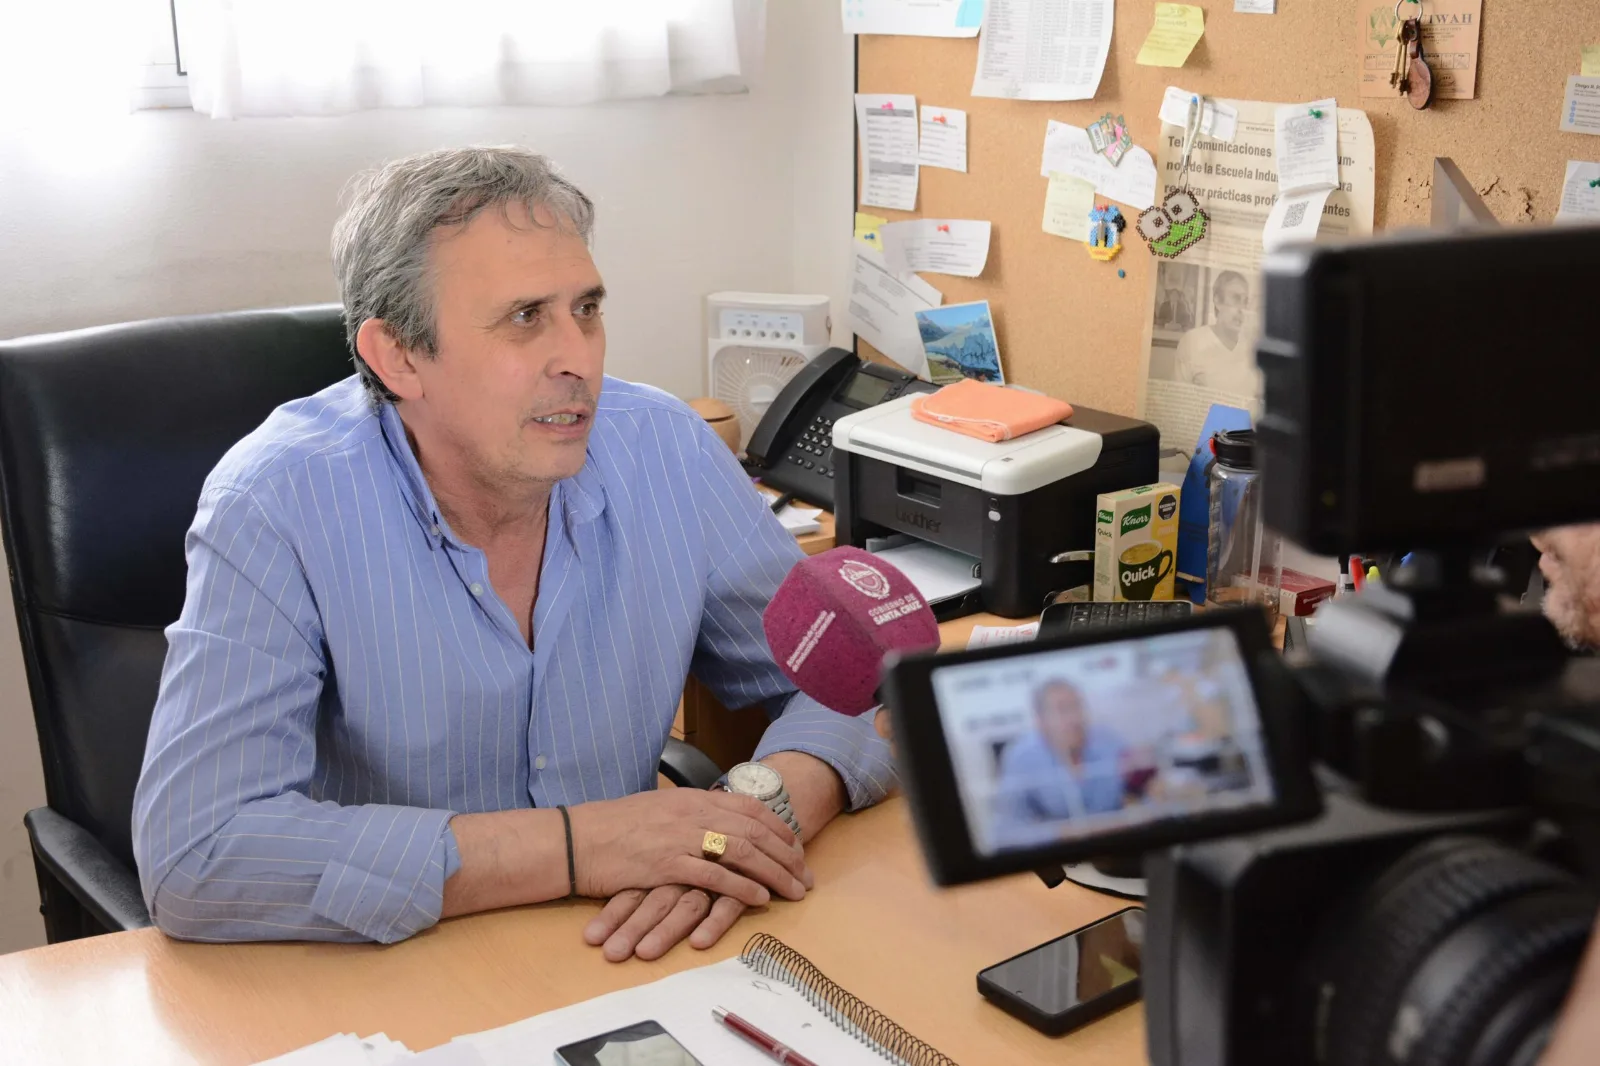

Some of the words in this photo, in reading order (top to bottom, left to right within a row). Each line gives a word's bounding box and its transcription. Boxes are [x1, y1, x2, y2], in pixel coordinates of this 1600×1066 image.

[1168, 136, 1272, 157] Telcomunicaciones
[1166, 161, 1186, 171] no
[1190, 161, 1202, 172] de
[1204, 162, 1213, 174] la
[1215, 164, 1253, 179] Escuela
[1255, 168, 1278, 183] Indu
[1207, 187, 1252, 203] prácticas
[1322, 203, 1350, 217] antes
[1098, 510, 1113, 522] Knorr
[1122, 513, 1149, 526] Knorr
[1097, 527, 1112, 539] Quick
[1121, 565, 1155, 586] Quick
[868, 598, 904, 616] GOBIERNO
[904, 593, 917, 602] DE
[873, 609, 902, 625] SANTA
[900, 600, 923, 615] CRUZ
